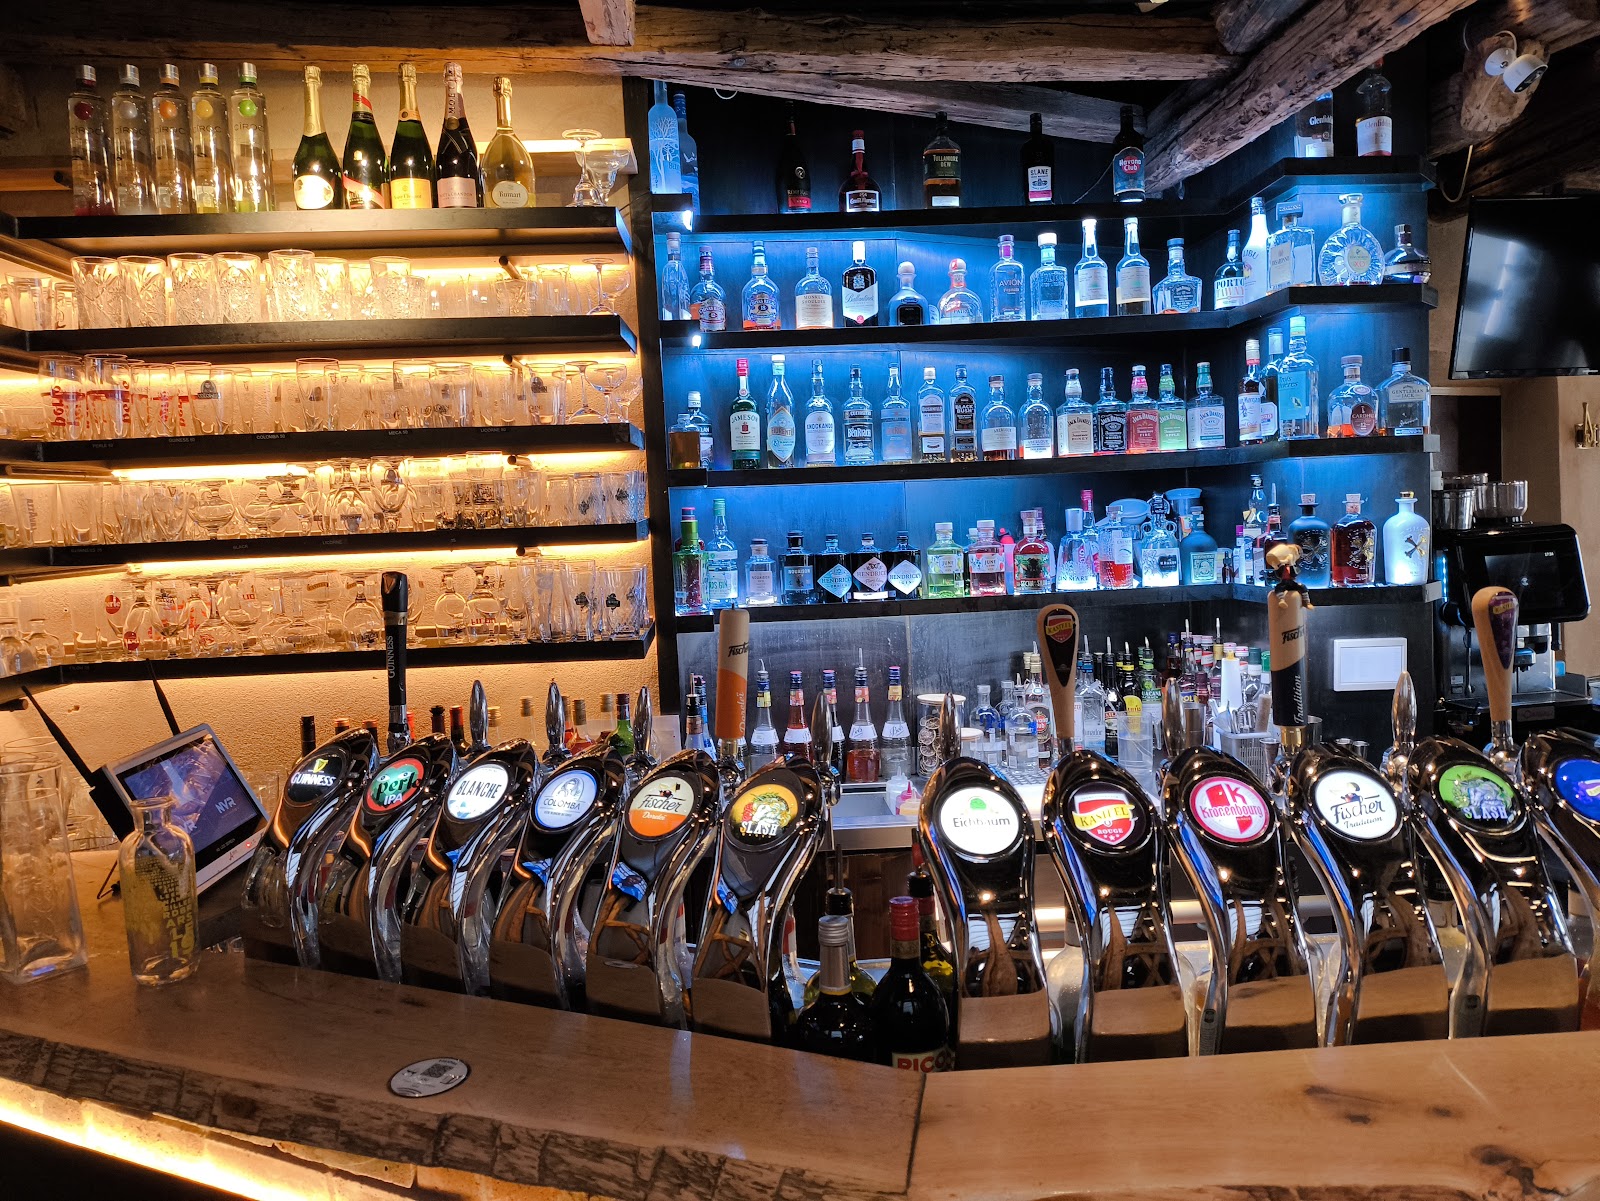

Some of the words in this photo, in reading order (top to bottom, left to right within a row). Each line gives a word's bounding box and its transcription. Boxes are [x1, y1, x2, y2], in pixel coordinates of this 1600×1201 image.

[1119, 158, 1141, 167] Havana
[1030, 168, 1049, 176] SLANE
[731, 414, 758, 423] JAMESON
[386, 635, 395, 679] GUINNESS
[1293, 675, 1304, 724] Tradition
[291, 772, 336, 786] GUINNESS
[376, 771, 422, 795] perle
[456, 779, 502, 799] BLANCHE
[215, 796, 237, 814] NVR
[384, 793, 403, 805] IPA
[543, 798, 581, 810] COLOMBA
[637, 794, 683, 812] Fischer
[1200, 804, 1263, 819] Kronenbourg
[1330, 801, 1385, 824] Fischer
[1463, 806, 1508, 820] SLASH
[740, 821, 779, 836] SLASH
[1343, 816, 1383, 829] Tradition
